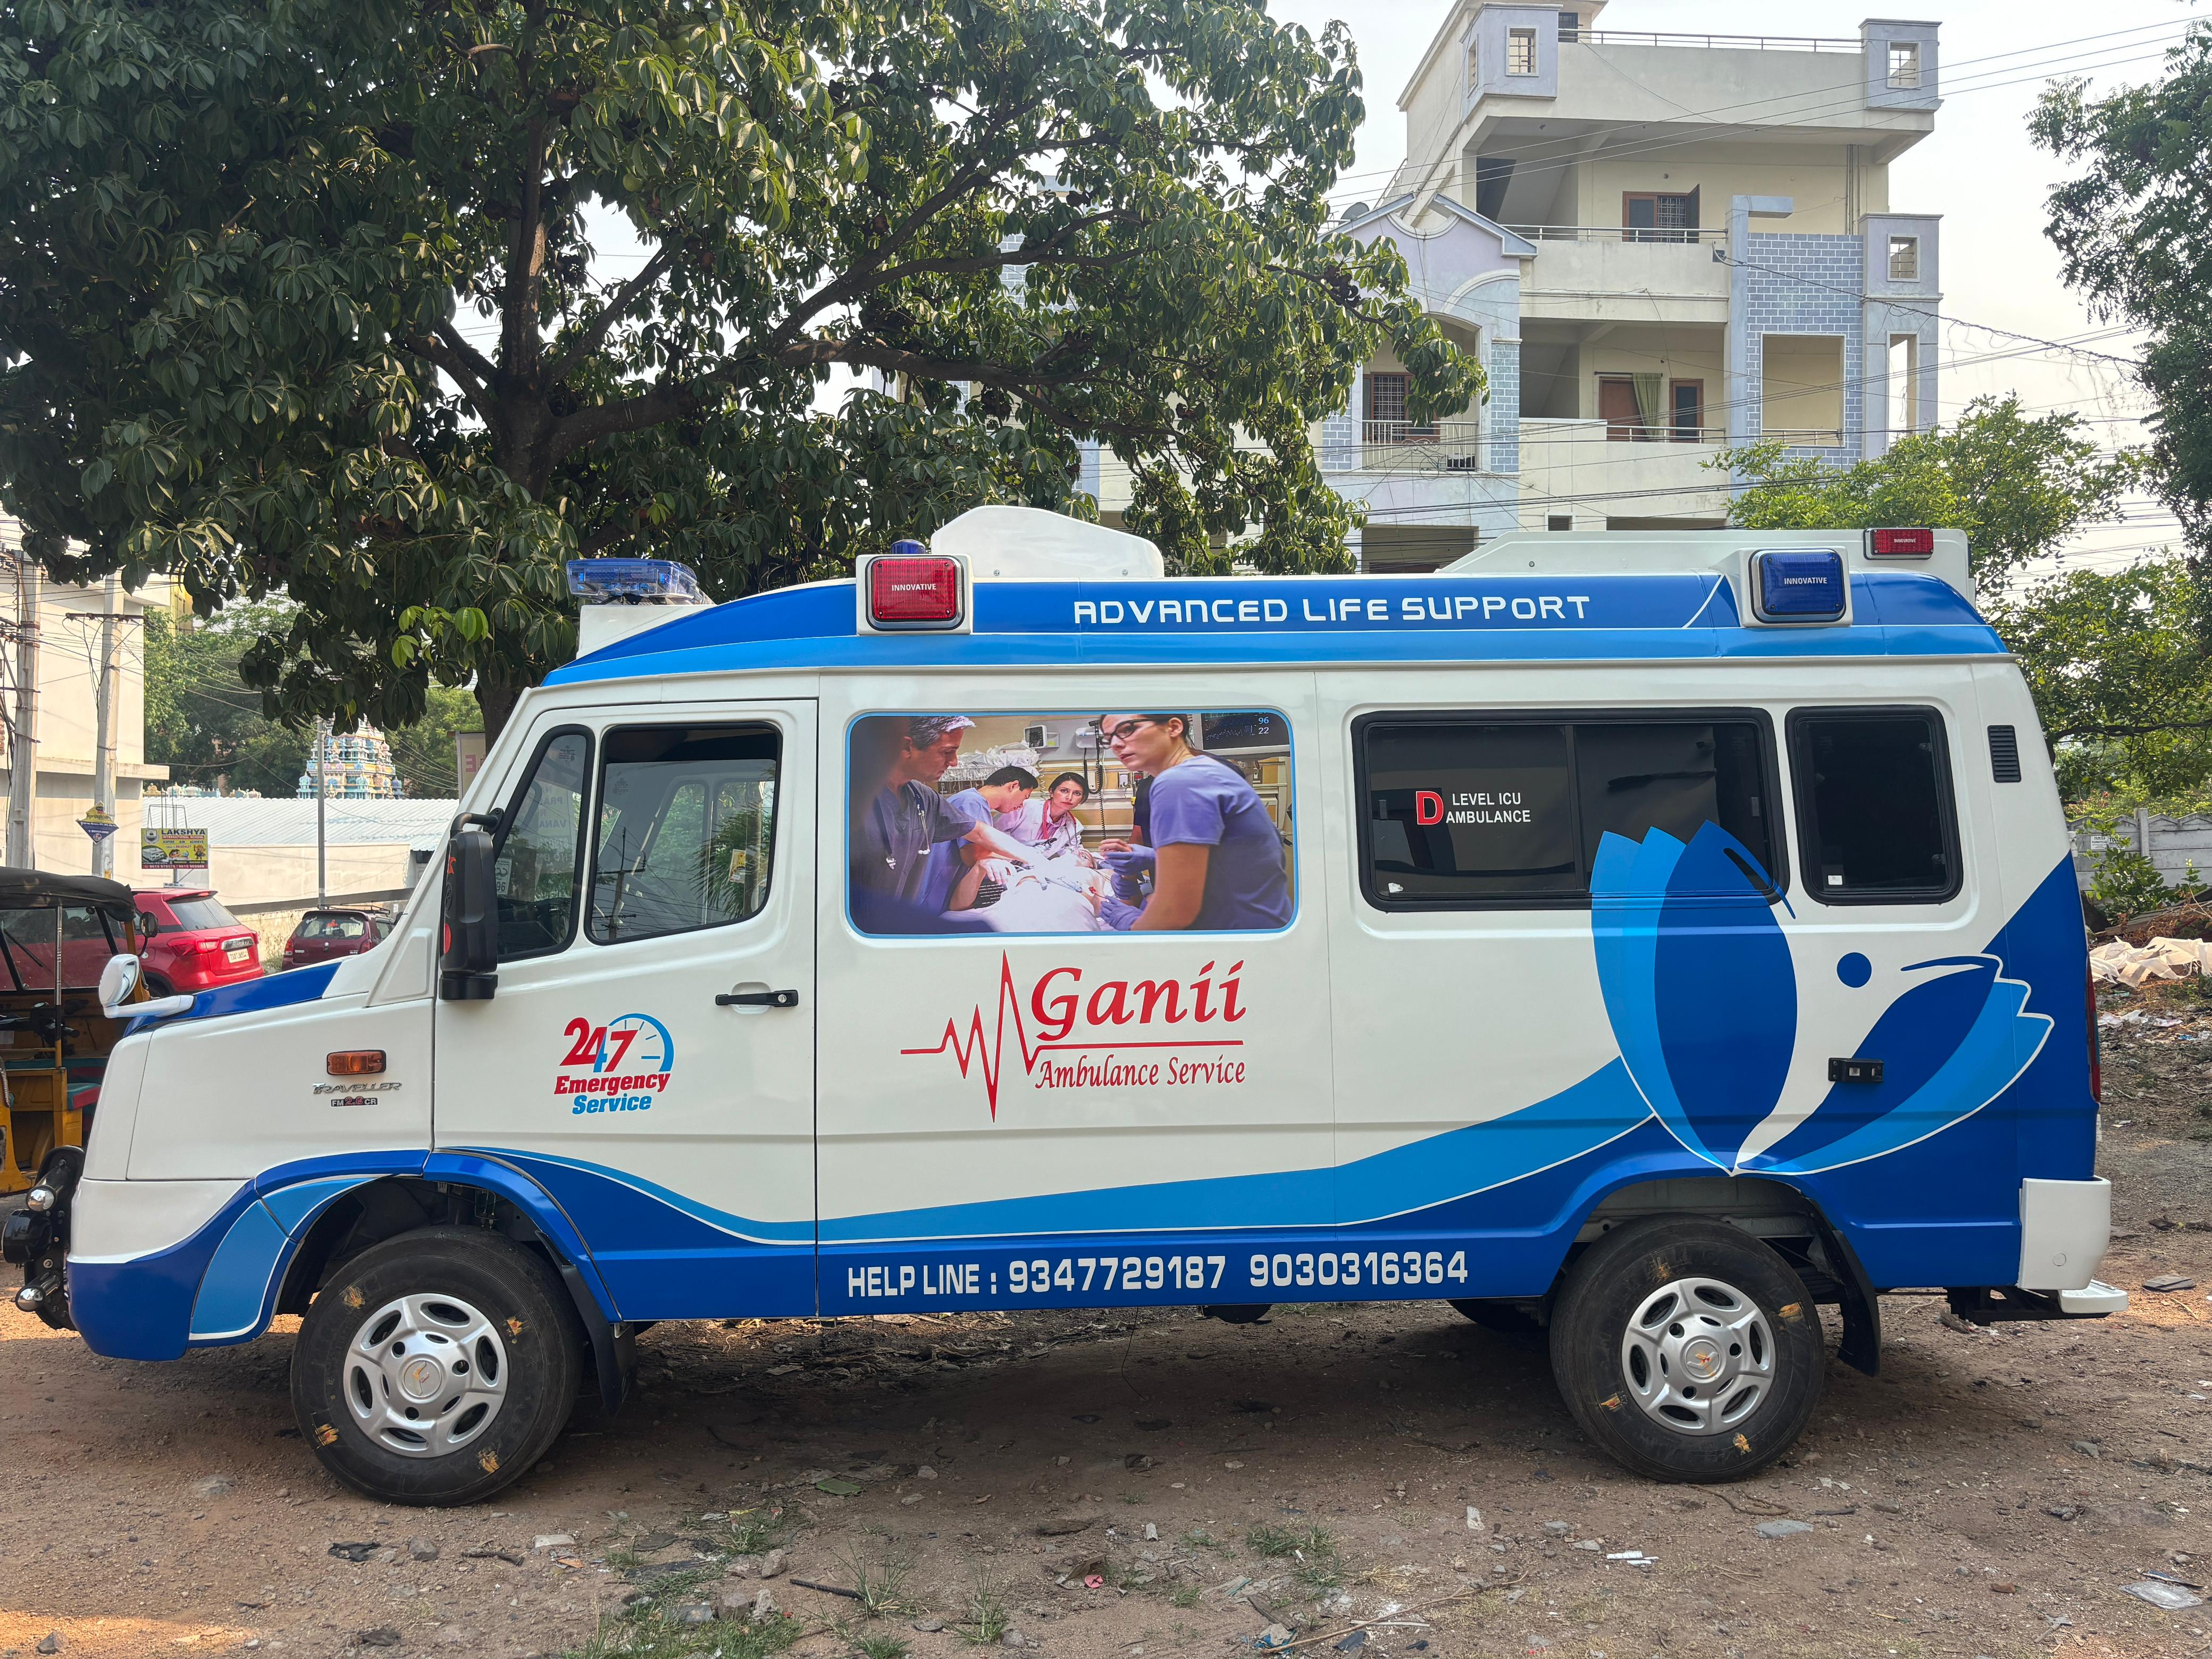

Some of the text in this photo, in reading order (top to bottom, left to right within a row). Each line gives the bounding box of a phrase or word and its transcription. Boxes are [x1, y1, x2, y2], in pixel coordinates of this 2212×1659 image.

[1074, 596, 1590, 624] ADVANCED LIFE SUPPORT
[1415, 791, 1521, 825] D LEVEL ICU
[1446, 810, 1531, 824] AMBULANCE
[1031, 960, 1246, 1041] Ganii
[554, 1073, 671, 1096] Emergency
[1035, 1054, 1245, 1089] Ambulance Service
[572, 1093, 652, 1115] Service
[848, 1266, 915, 1297] HELP
[924, 1264, 979, 1295] LINE
[1009, 1255, 1226, 1293] 9347729187
[1250, 1251, 1468, 1287] 9030316364
